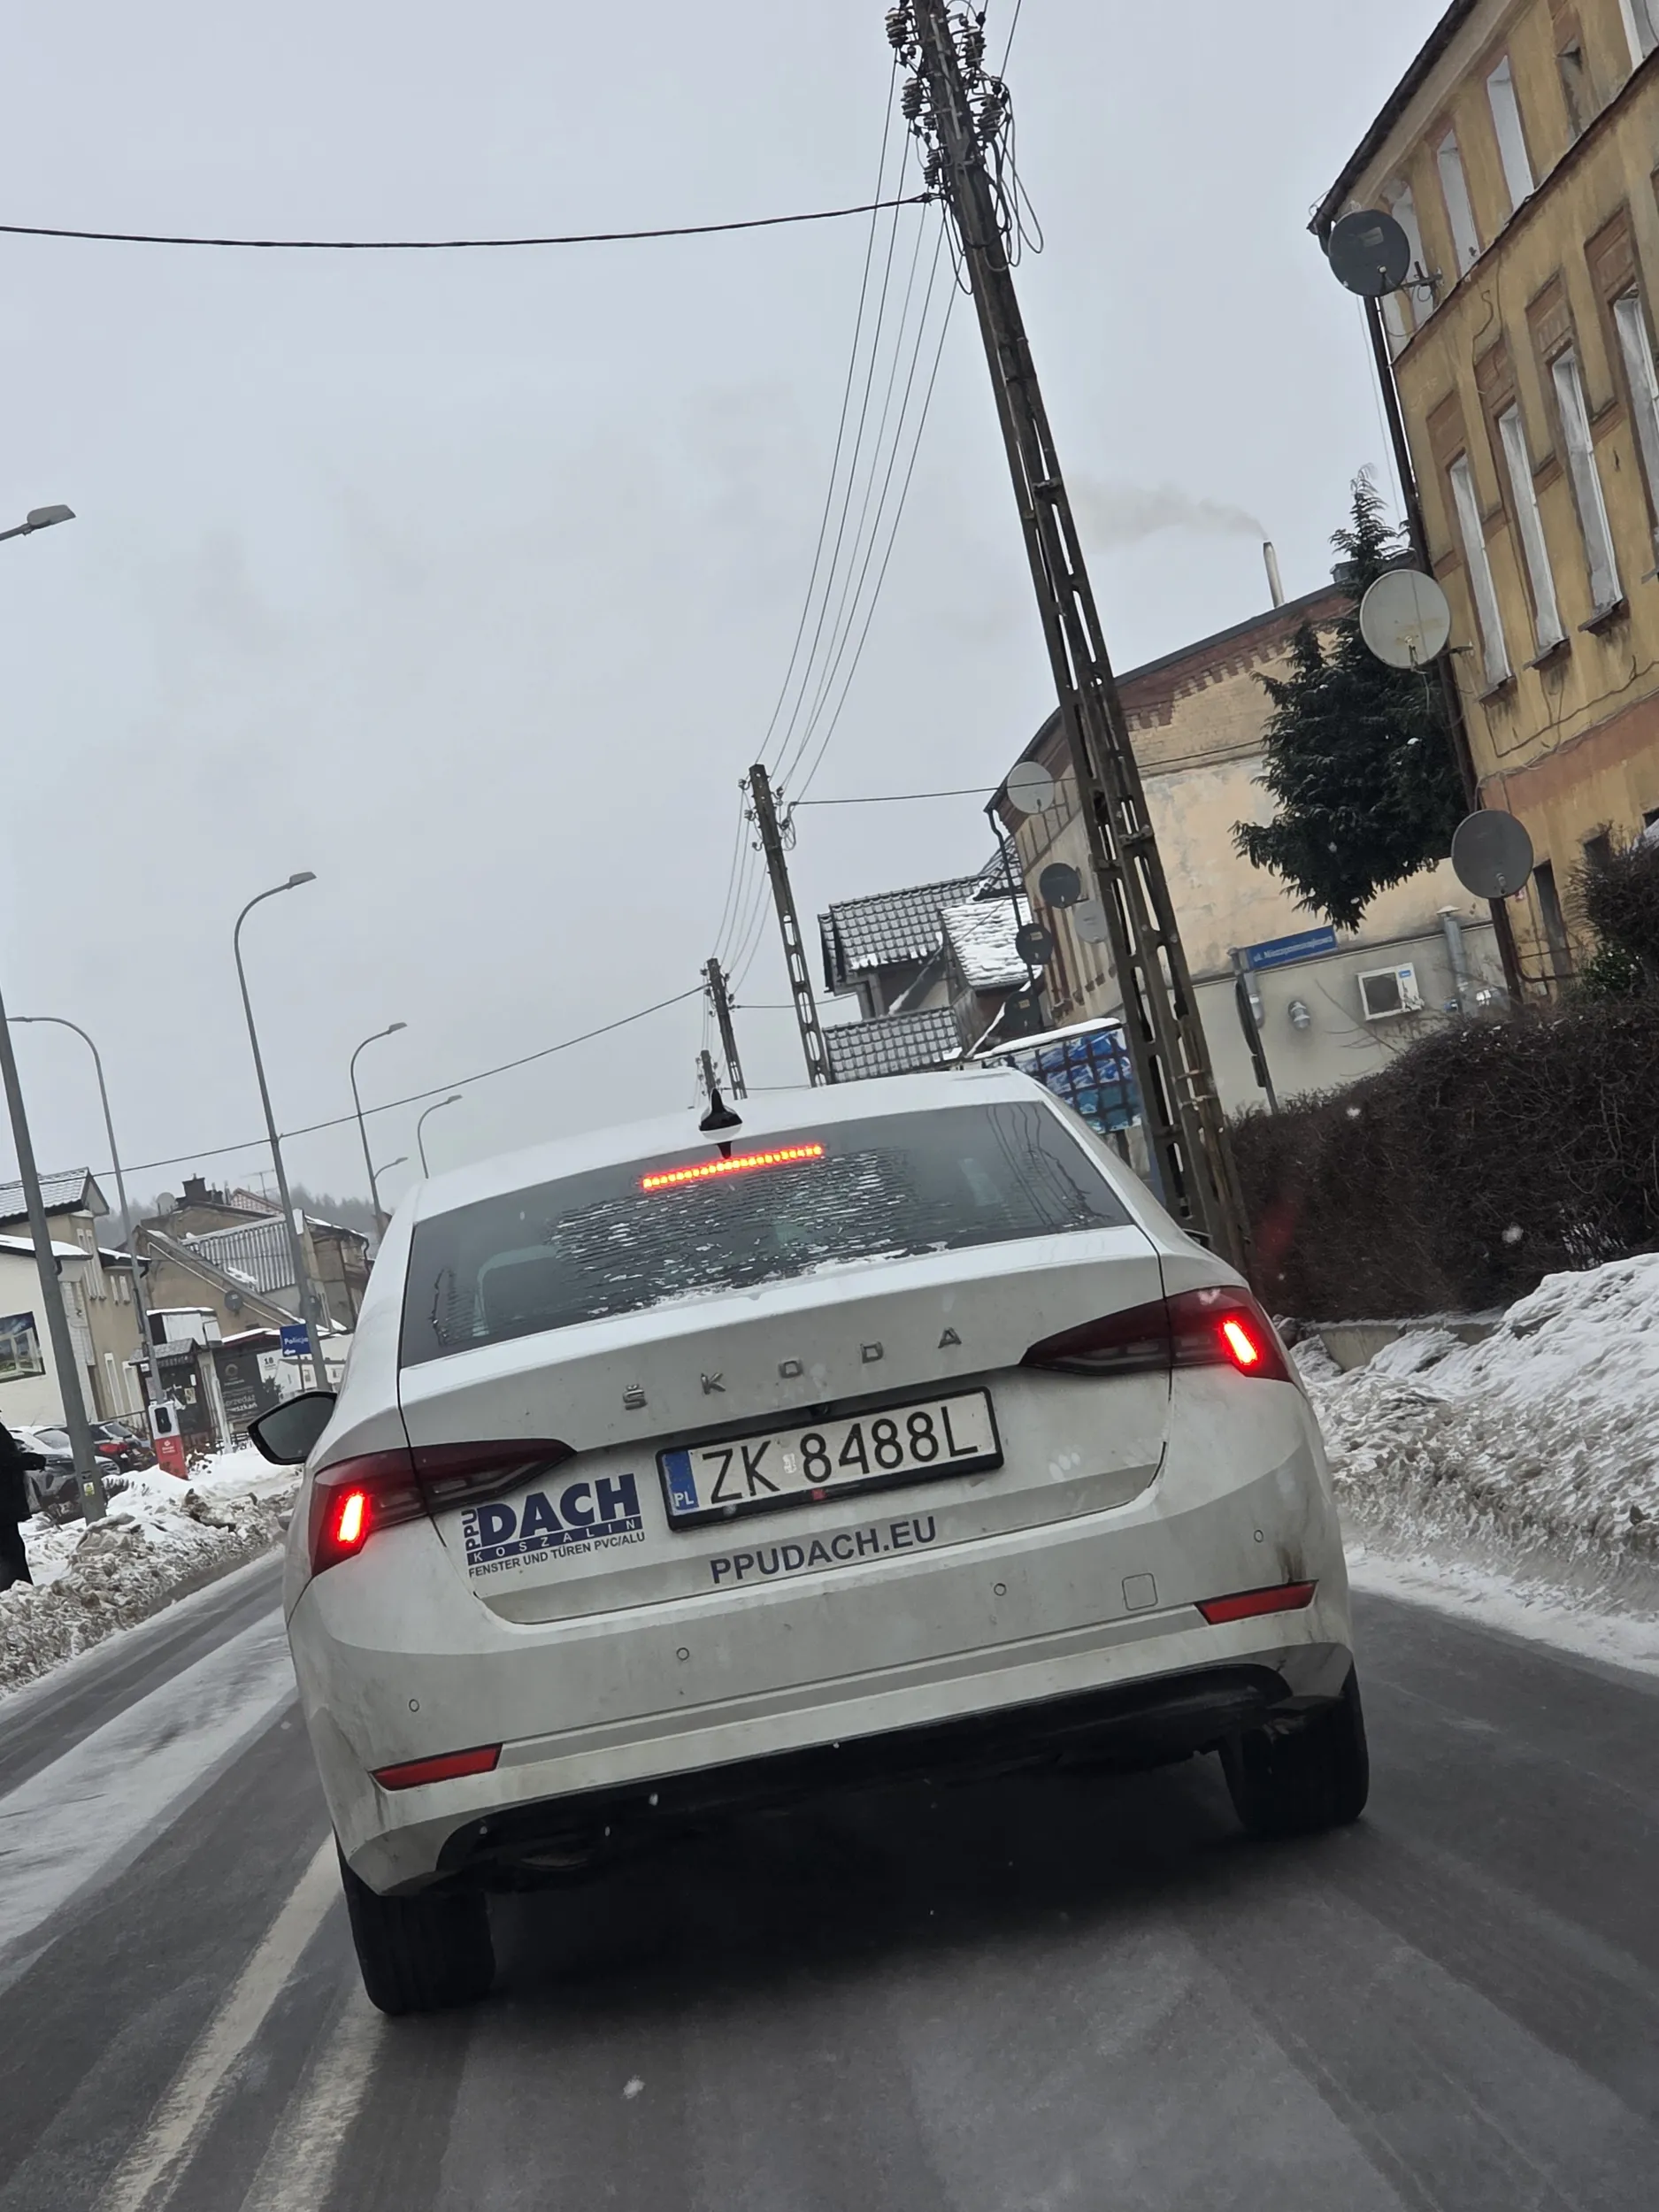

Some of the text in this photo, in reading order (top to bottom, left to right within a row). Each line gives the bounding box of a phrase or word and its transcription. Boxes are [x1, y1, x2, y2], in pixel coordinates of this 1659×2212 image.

[283, 1336, 309, 1345] Policja
[622, 1327, 962, 1410] ŠKODA
[702, 1406, 979, 1504] ZK 8488L
[477, 1473, 641, 1548] DACH
[674, 1491, 695, 1507] PL
[461, 1509, 482, 1552] PPU
[473, 1518, 636, 1563] KOSZALIN
[710, 1516, 937, 1584] PPUDACH.EU
[468, 1532, 646, 1578] FENSTER UND TÜREN PVC/ALU
